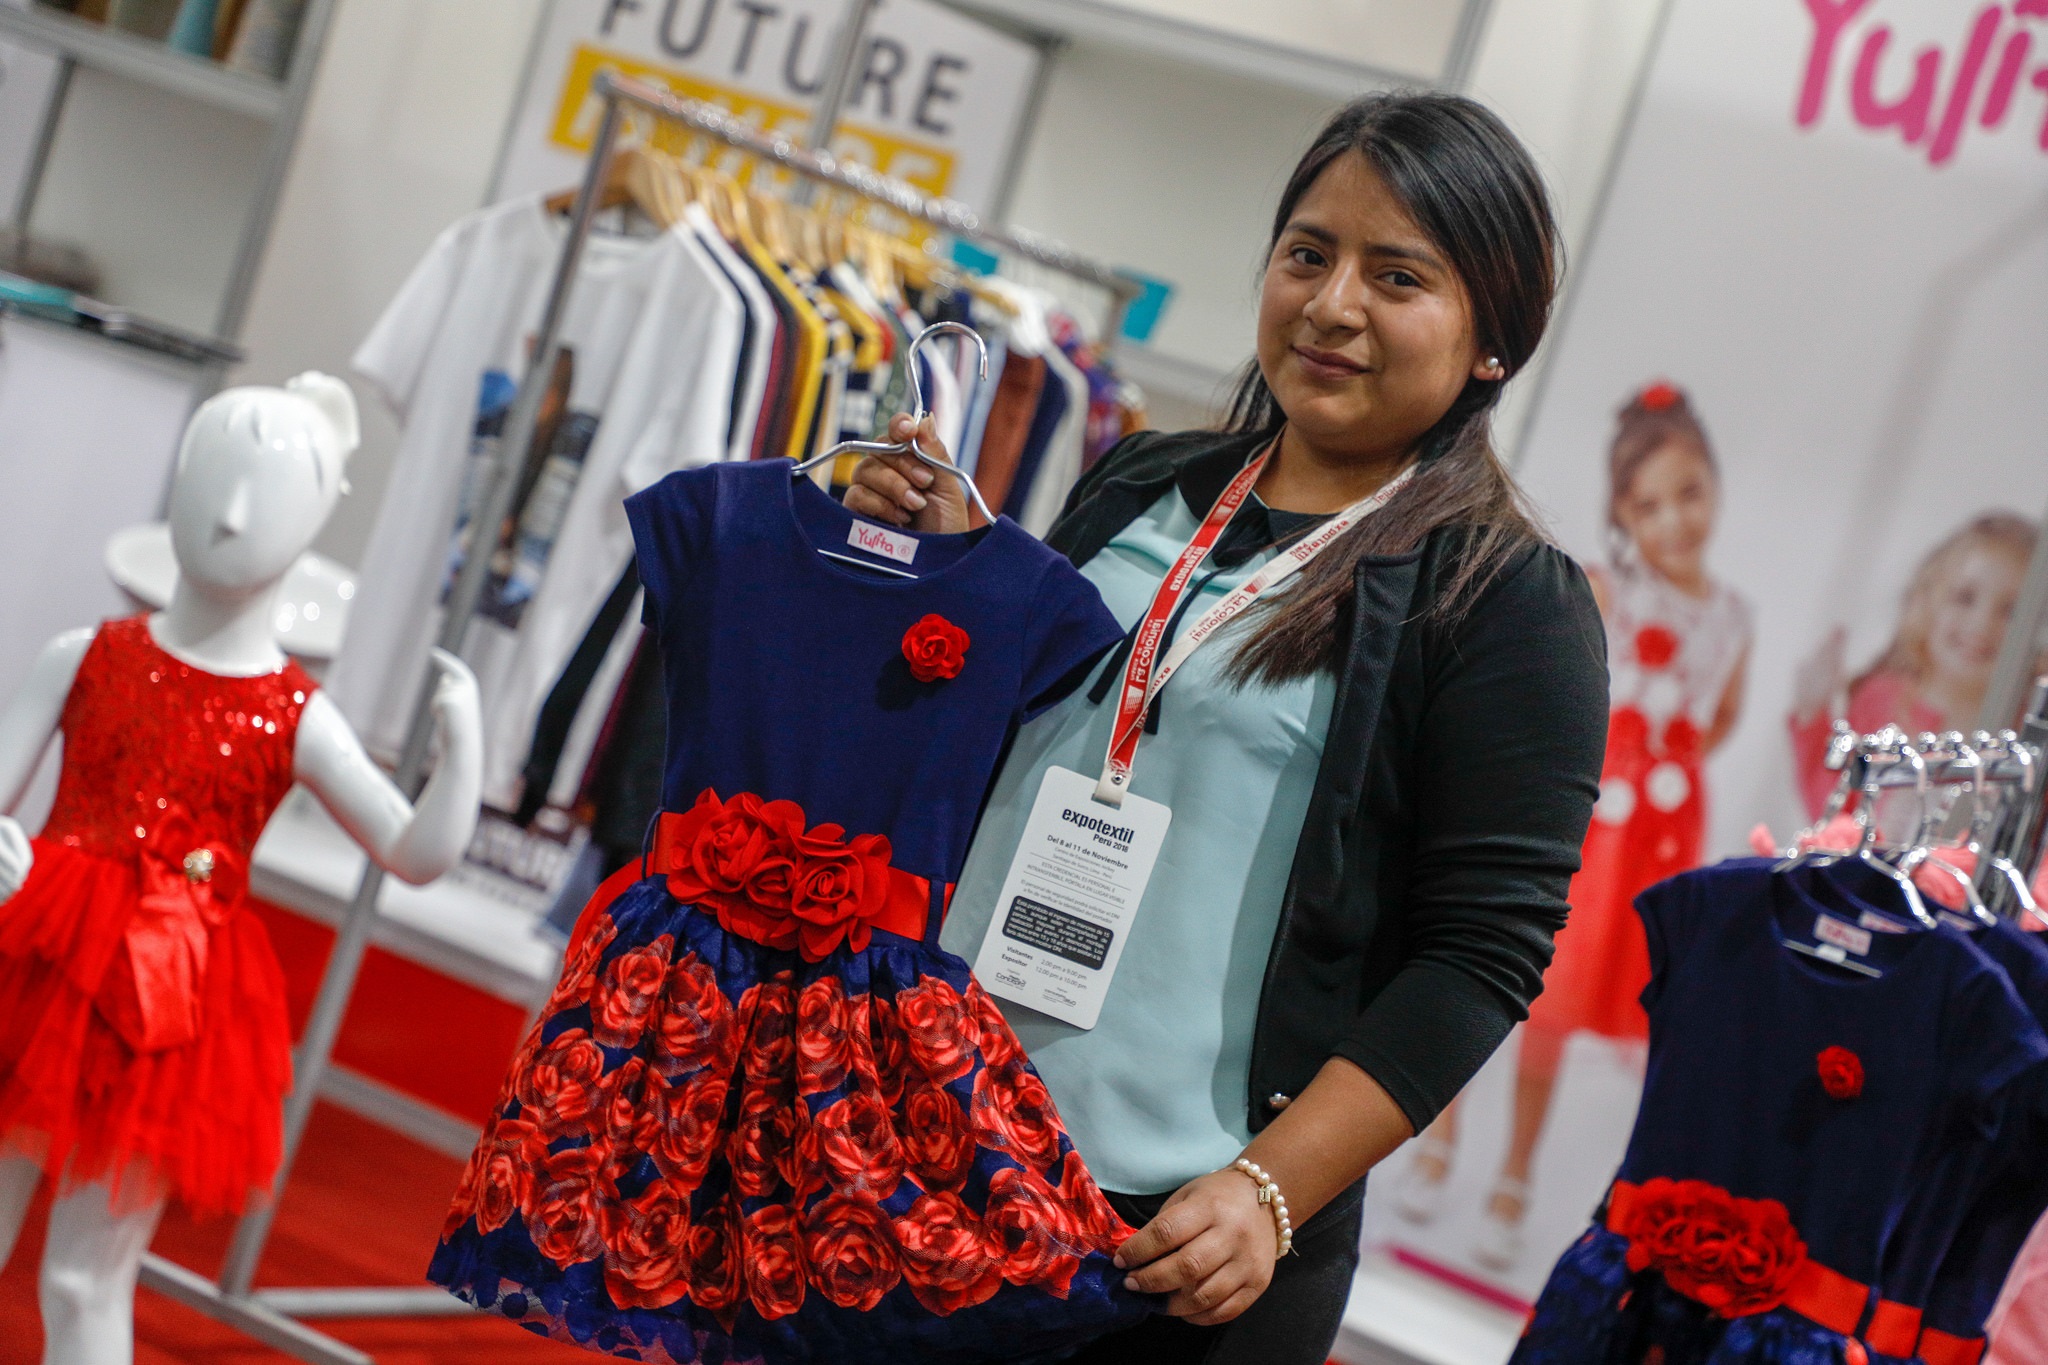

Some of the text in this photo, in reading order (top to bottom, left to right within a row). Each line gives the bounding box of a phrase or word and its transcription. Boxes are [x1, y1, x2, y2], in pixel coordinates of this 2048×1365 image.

[859, 526, 894, 554] Yulita
[1191, 593, 1248, 642] La Colonial
[1061, 808, 1134, 843] expotextil
[1046, 834, 1059, 843] Del
[1073, 843, 1081, 852] 11
[1091, 850, 1128, 869] Noviembre
[1092, 833, 1128, 852] Perú 2018
[1001, 953, 1028, 967] Expositor
[1006, 946, 1033, 960] Visitantes
